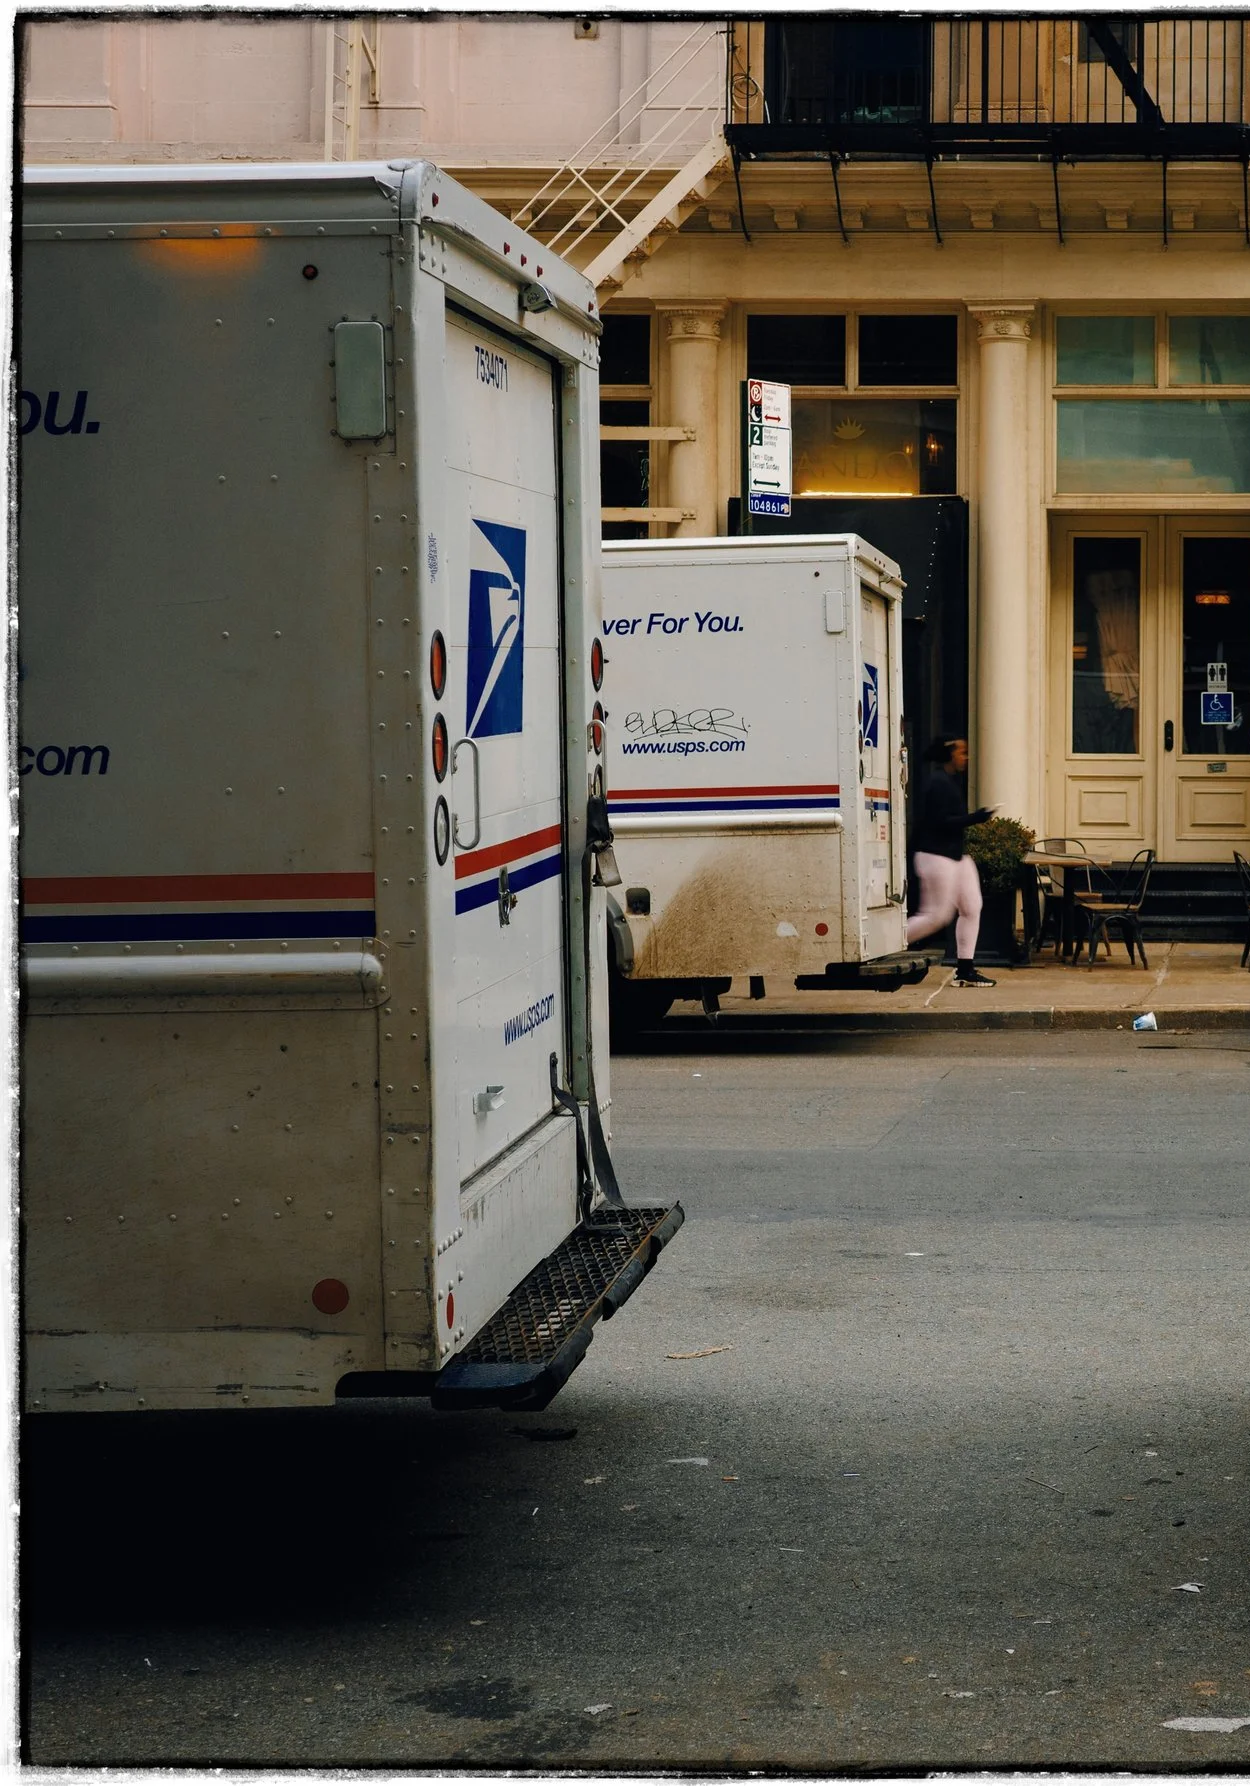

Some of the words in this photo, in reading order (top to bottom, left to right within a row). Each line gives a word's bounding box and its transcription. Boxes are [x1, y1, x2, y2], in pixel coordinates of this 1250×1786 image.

[475, 345, 508, 392] 7534071
[753, 426, 760, 445] 2
[602, 618, 642, 635] ver
[646, 612, 690, 634] For
[694, 611, 744, 633] You.
[622, 740, 746, 756] www.usps.com
[503, 993, 555, 1046] www.usps.com
